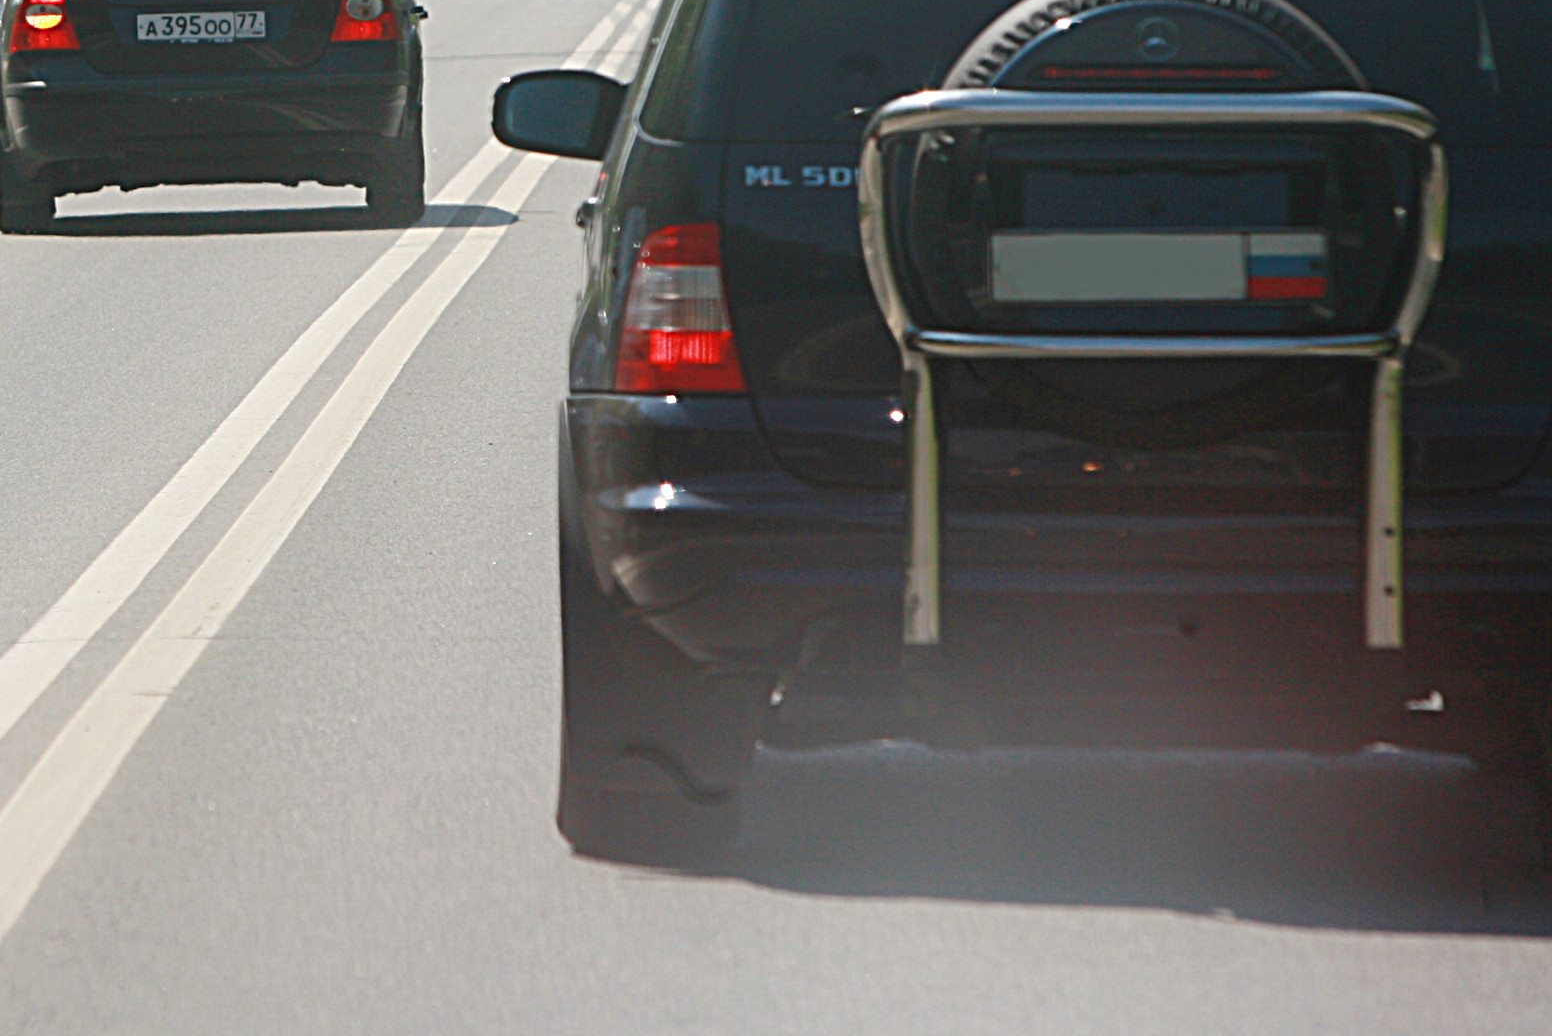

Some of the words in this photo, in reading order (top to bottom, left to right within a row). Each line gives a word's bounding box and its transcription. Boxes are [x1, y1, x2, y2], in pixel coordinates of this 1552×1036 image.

[236, 13, 258, 29] 77
[745, 165, 792, 187] ML
[801, 165, 862, 187] 50
